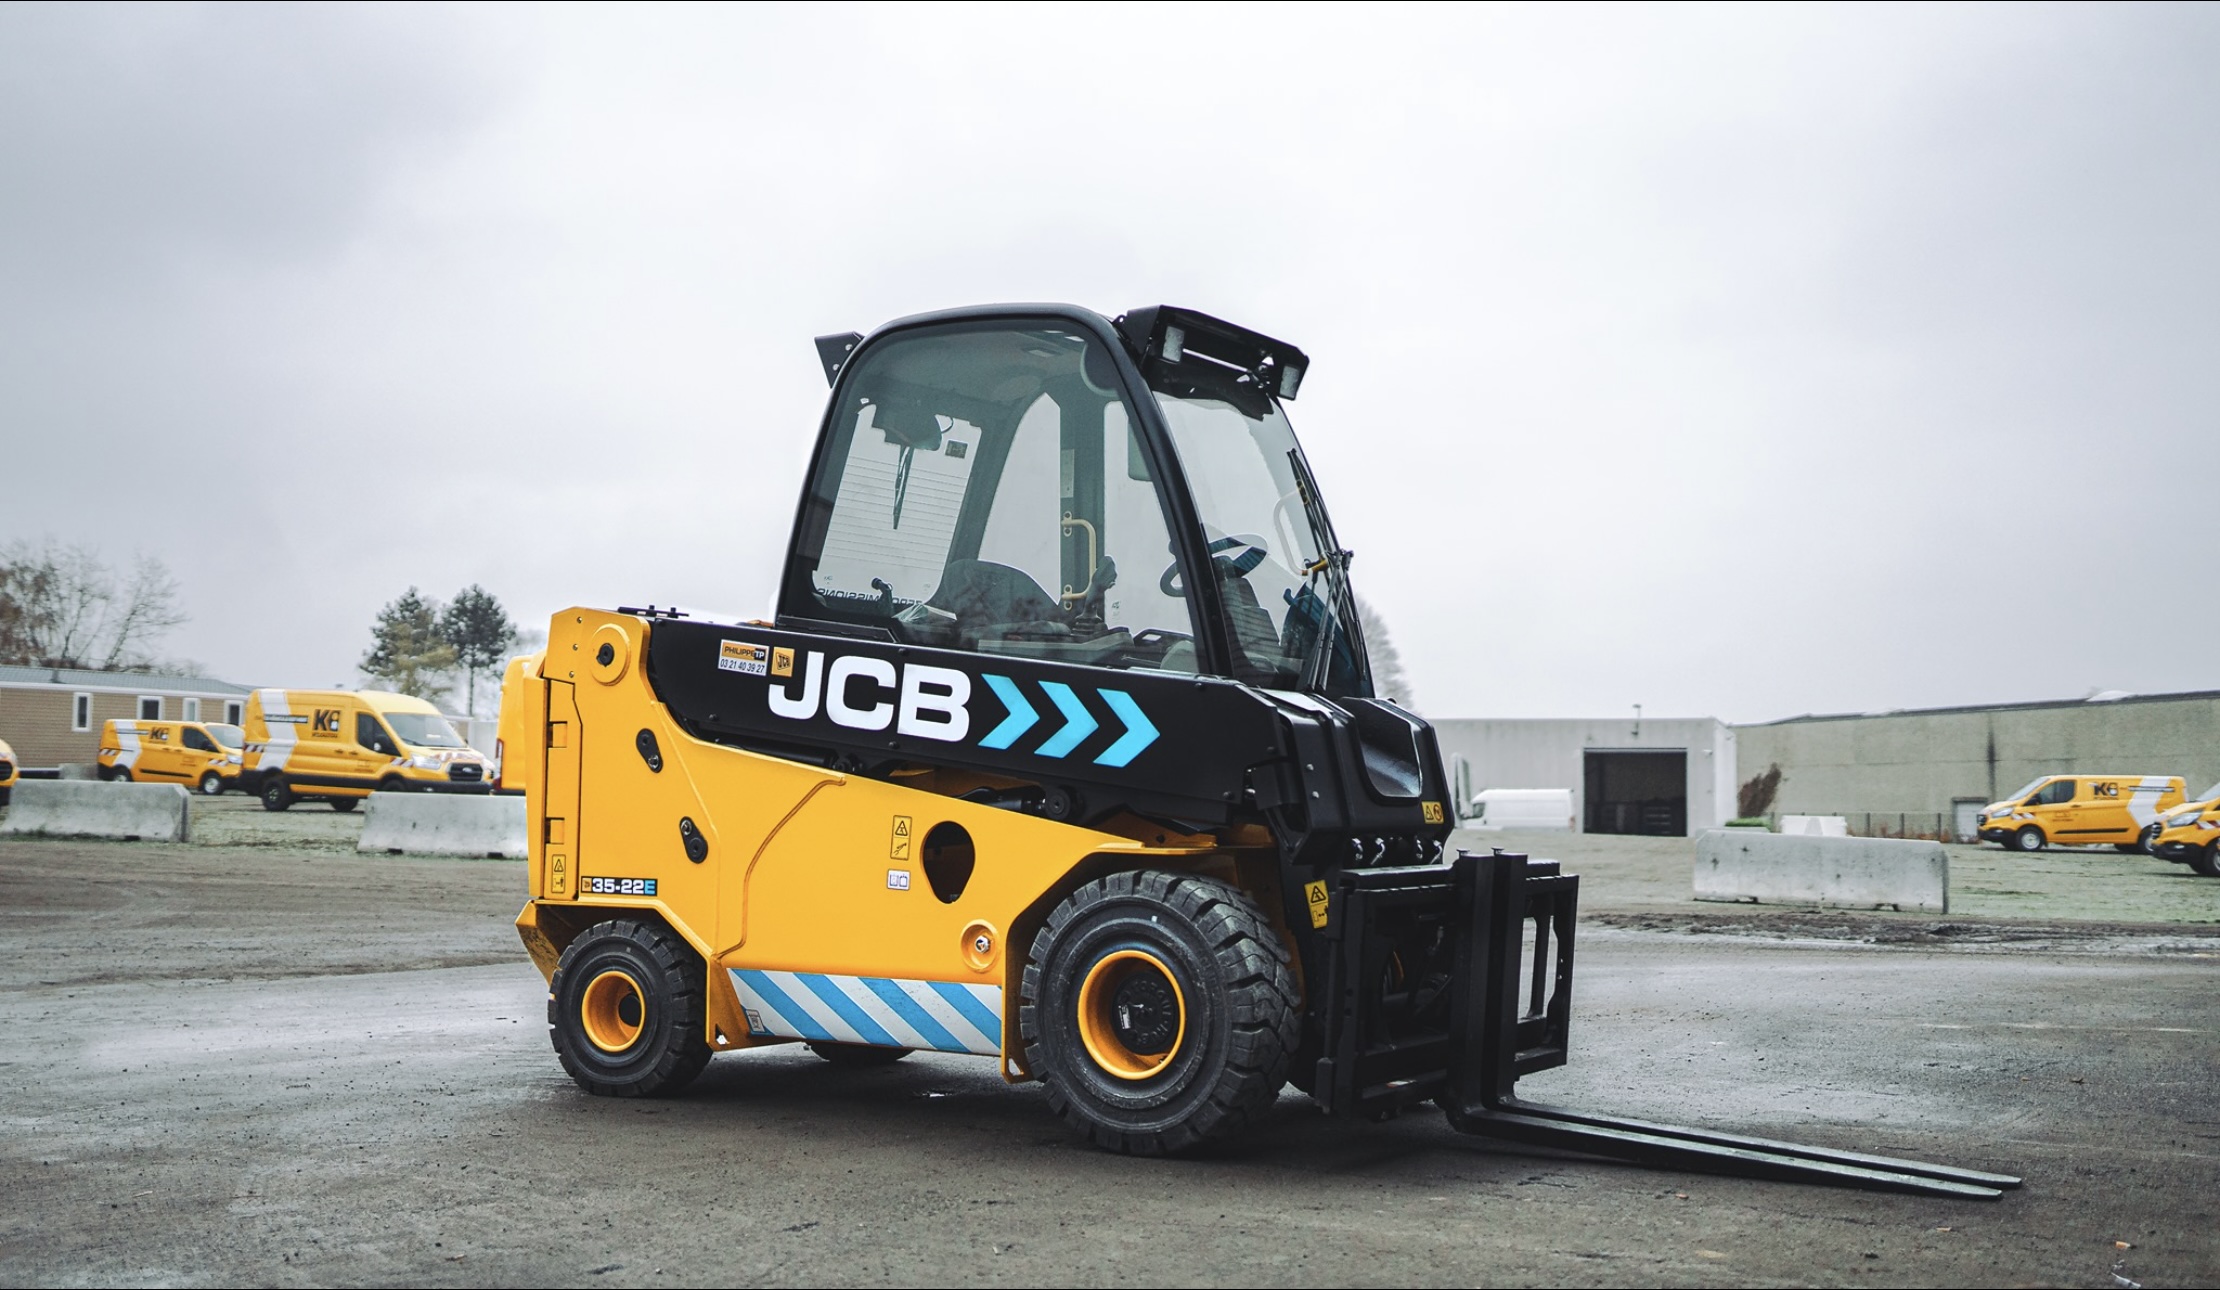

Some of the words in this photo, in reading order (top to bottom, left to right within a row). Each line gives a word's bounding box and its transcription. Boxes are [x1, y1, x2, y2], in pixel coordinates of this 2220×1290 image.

[720, 658, 728, 668] 03
[729, 660, 737, 669] 21
[738, 661, 747, 671] 40
[747, 663, 756, 672] 39
[756, 664, 765, 674] 27
[768, 651, 972, 743] JCB
[592, 877, 656, 895] 35-22E
